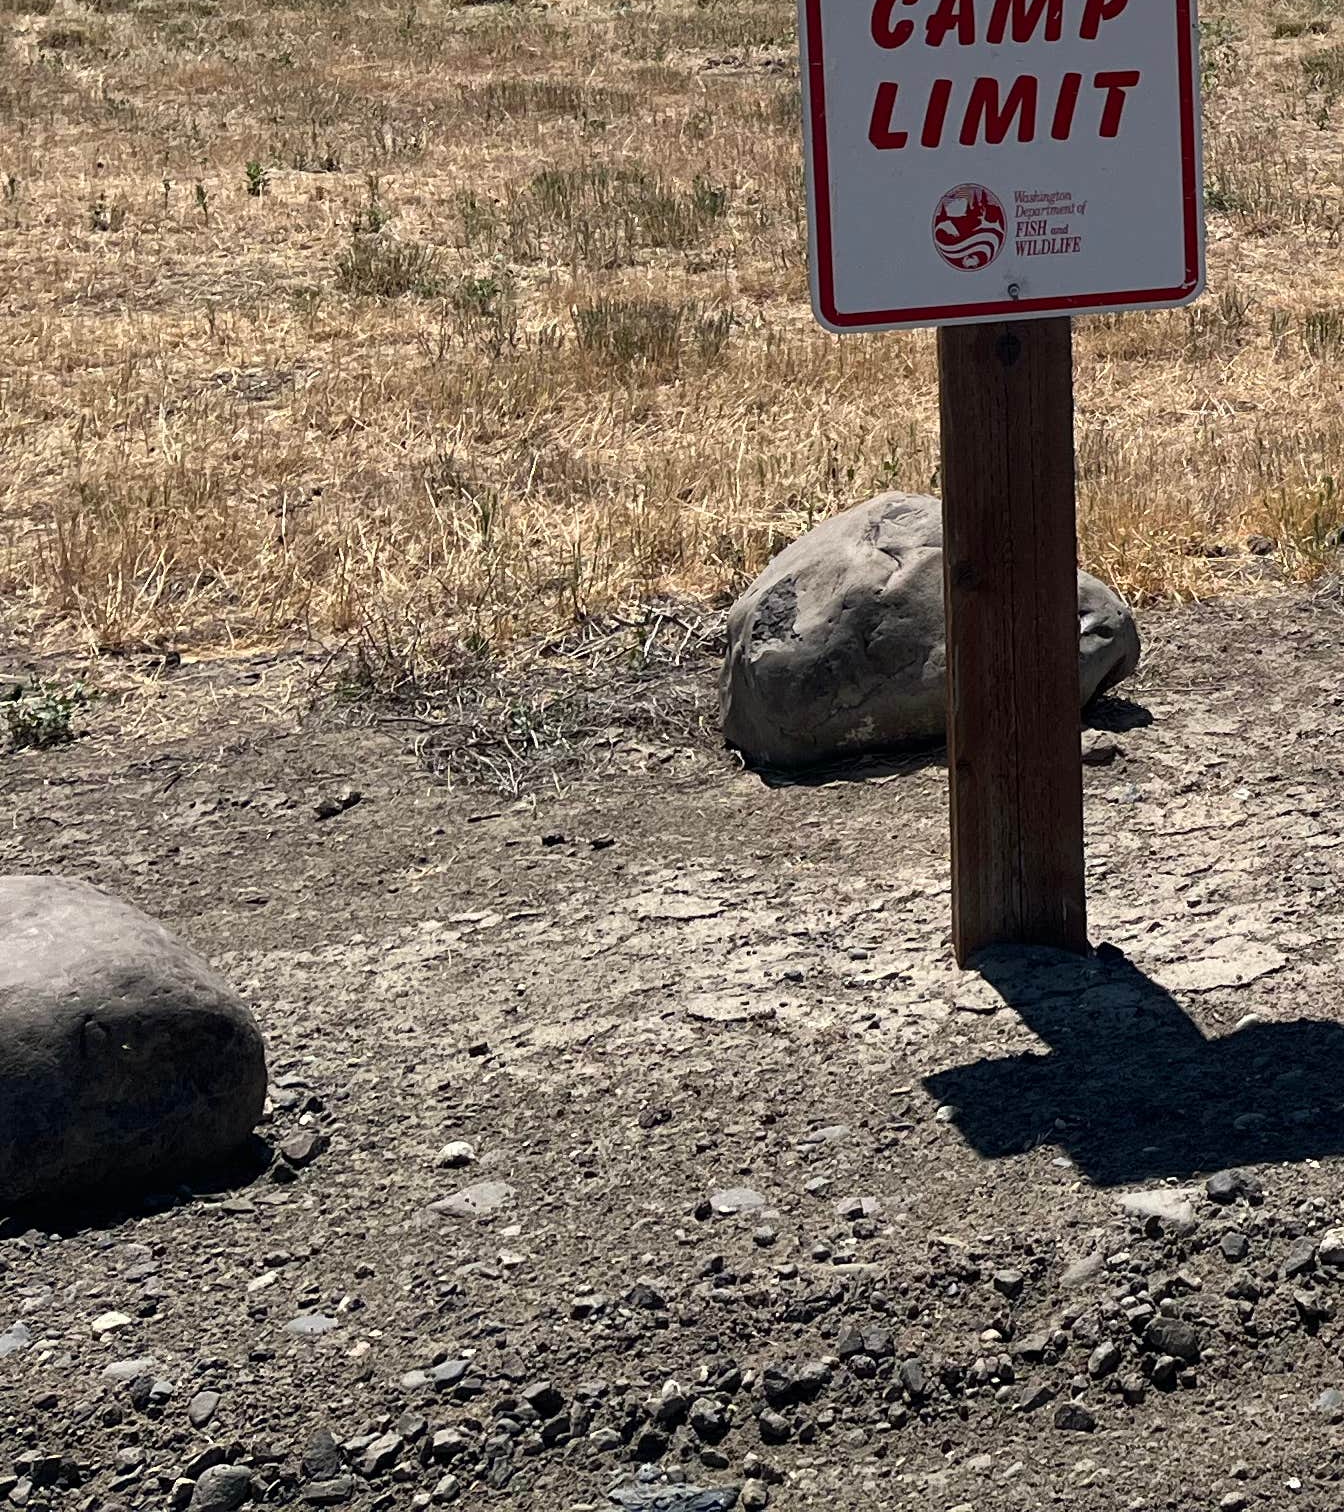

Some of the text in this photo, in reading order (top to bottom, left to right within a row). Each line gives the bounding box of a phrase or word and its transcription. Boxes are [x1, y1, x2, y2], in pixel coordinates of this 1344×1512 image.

[868, 70, 1140, 150] LIMIT
[1014, 190, 1072, 206] Washington
[1015, 200, 1087, 220] Department of
[1016, 220, 1068, 237] FISH and
[1016, 236, 1081, 256] WILDLIFE
